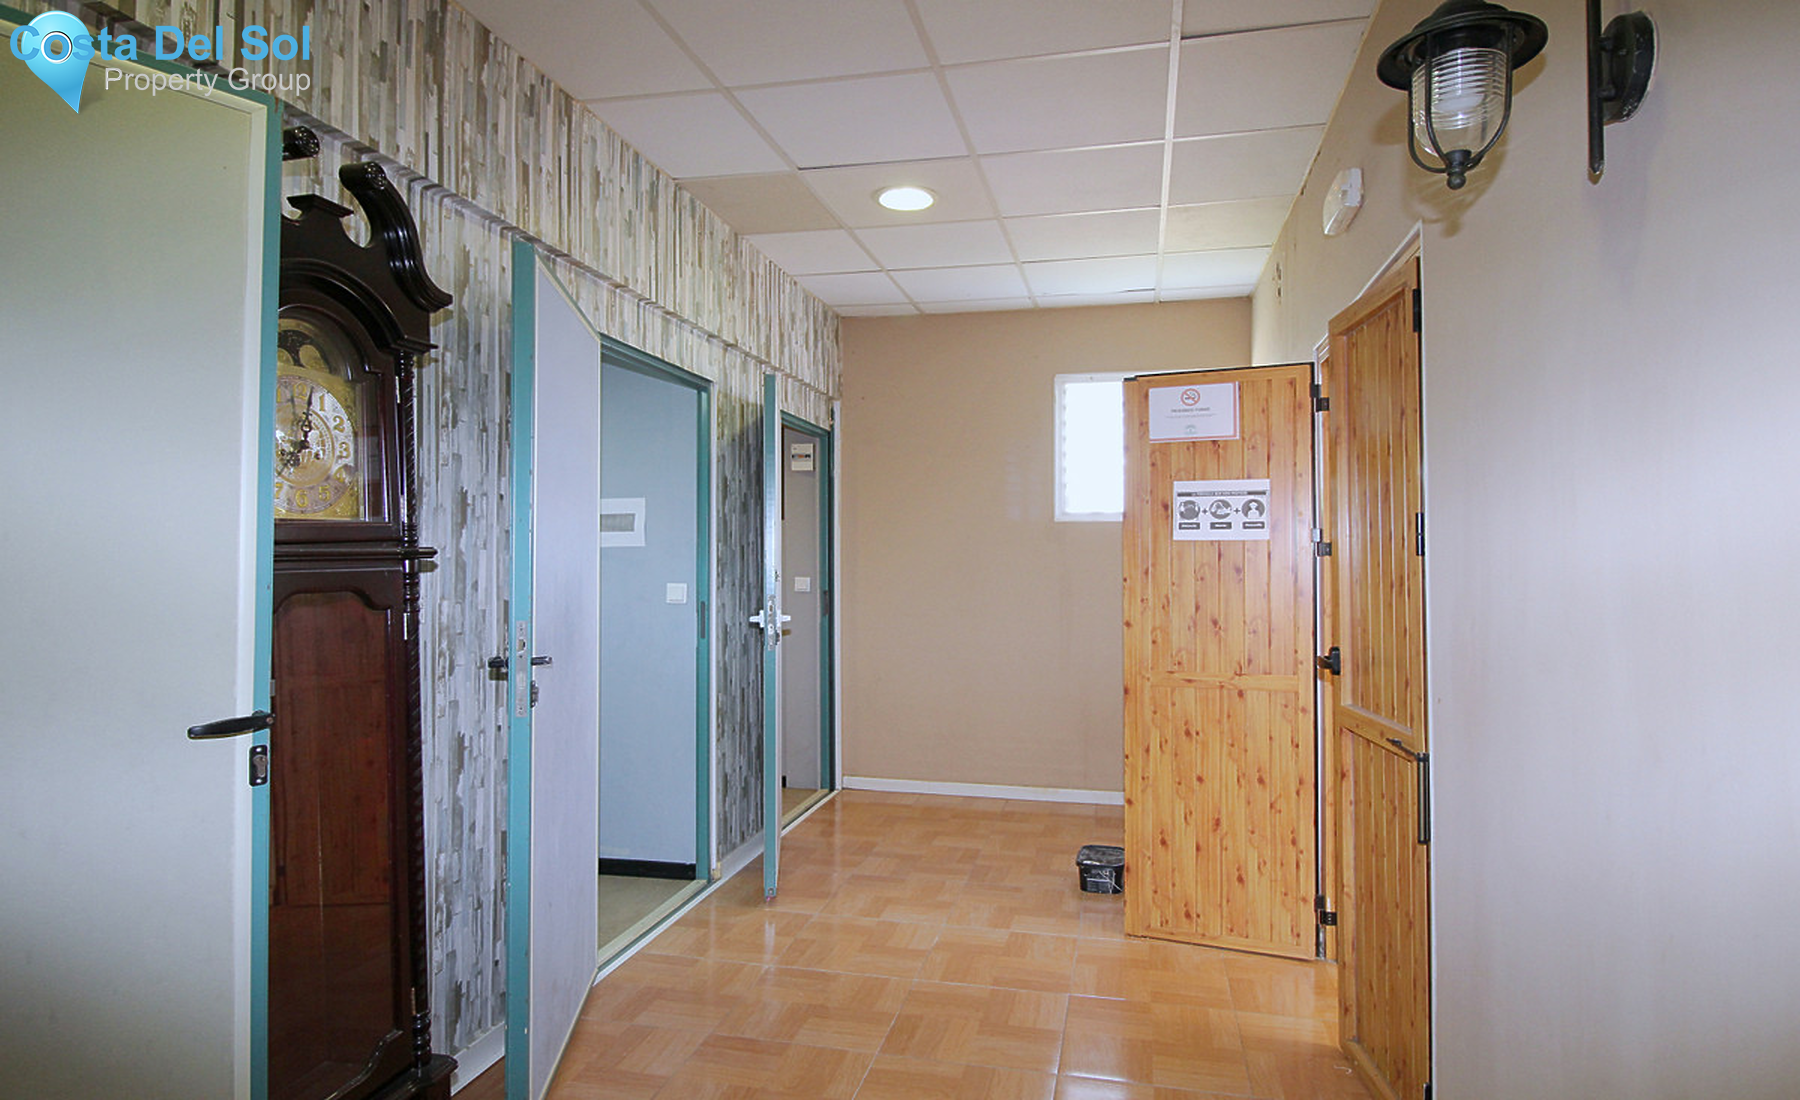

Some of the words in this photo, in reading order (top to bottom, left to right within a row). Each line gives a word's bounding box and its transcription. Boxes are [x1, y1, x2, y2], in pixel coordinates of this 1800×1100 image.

[319, 393, 326, 412] 1
[333, 416, 345, 433] 2
[339, 442, 350, 459] 3
[296, 490, 308, 508] 6
[318, 485, 330, 502] 5
